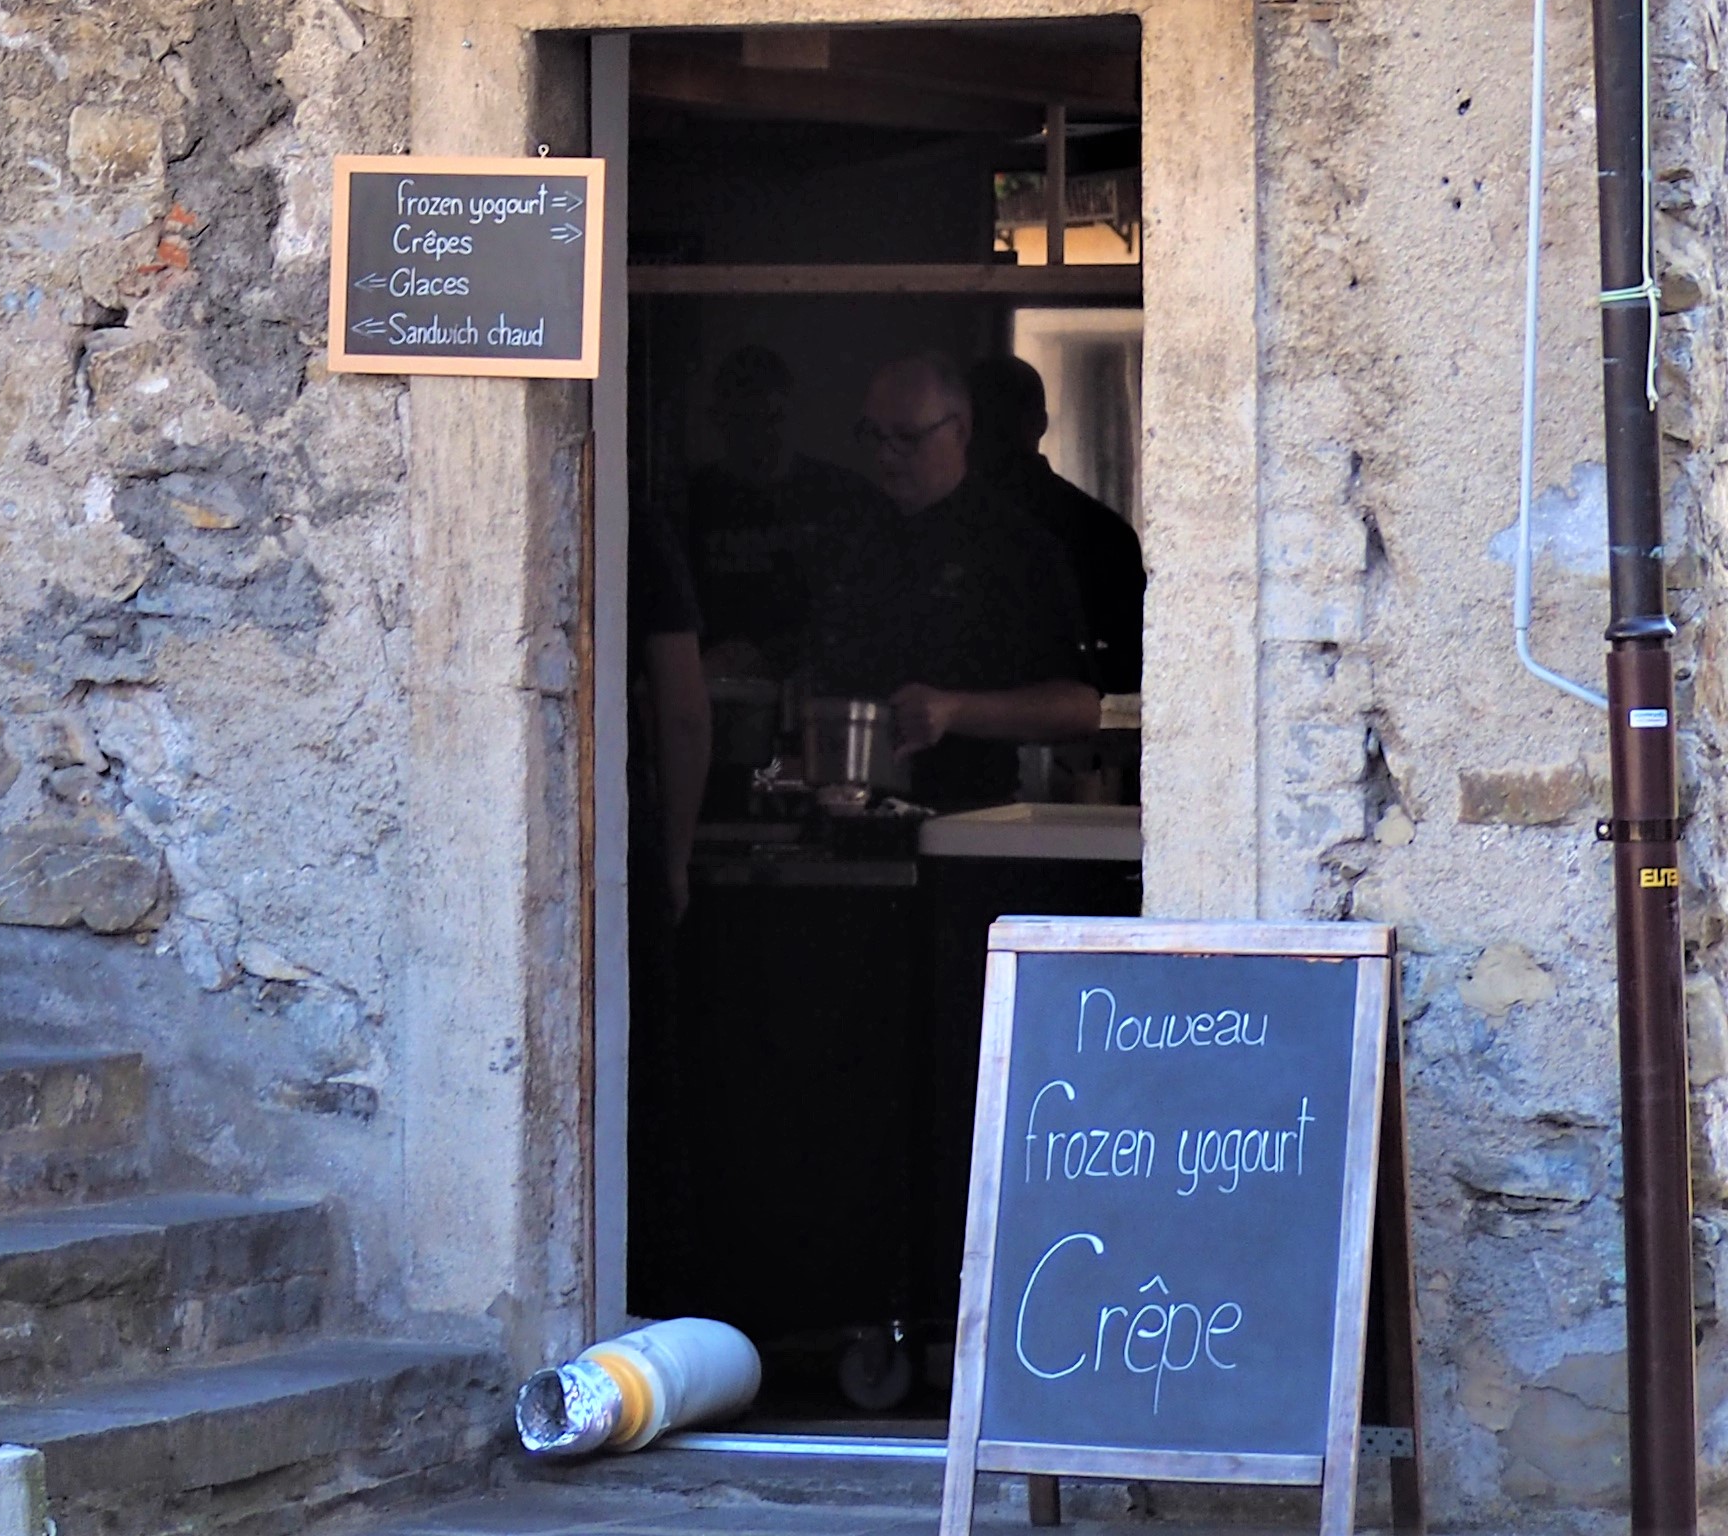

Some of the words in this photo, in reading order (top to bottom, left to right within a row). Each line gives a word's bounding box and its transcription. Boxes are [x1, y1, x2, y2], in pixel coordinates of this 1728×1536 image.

[469, 183, 549, 224] yogourt
[392, 223, 473, 261] Crêpes
[389, 267, 470, 297] Glaces
[388, 312, 478, 346] Sandwich
[487, 313, 545, 347] chaud
[1177, 1096, 1316, 1196] yogourt
[1016, 1233, 1243, 1416] Crêpe
